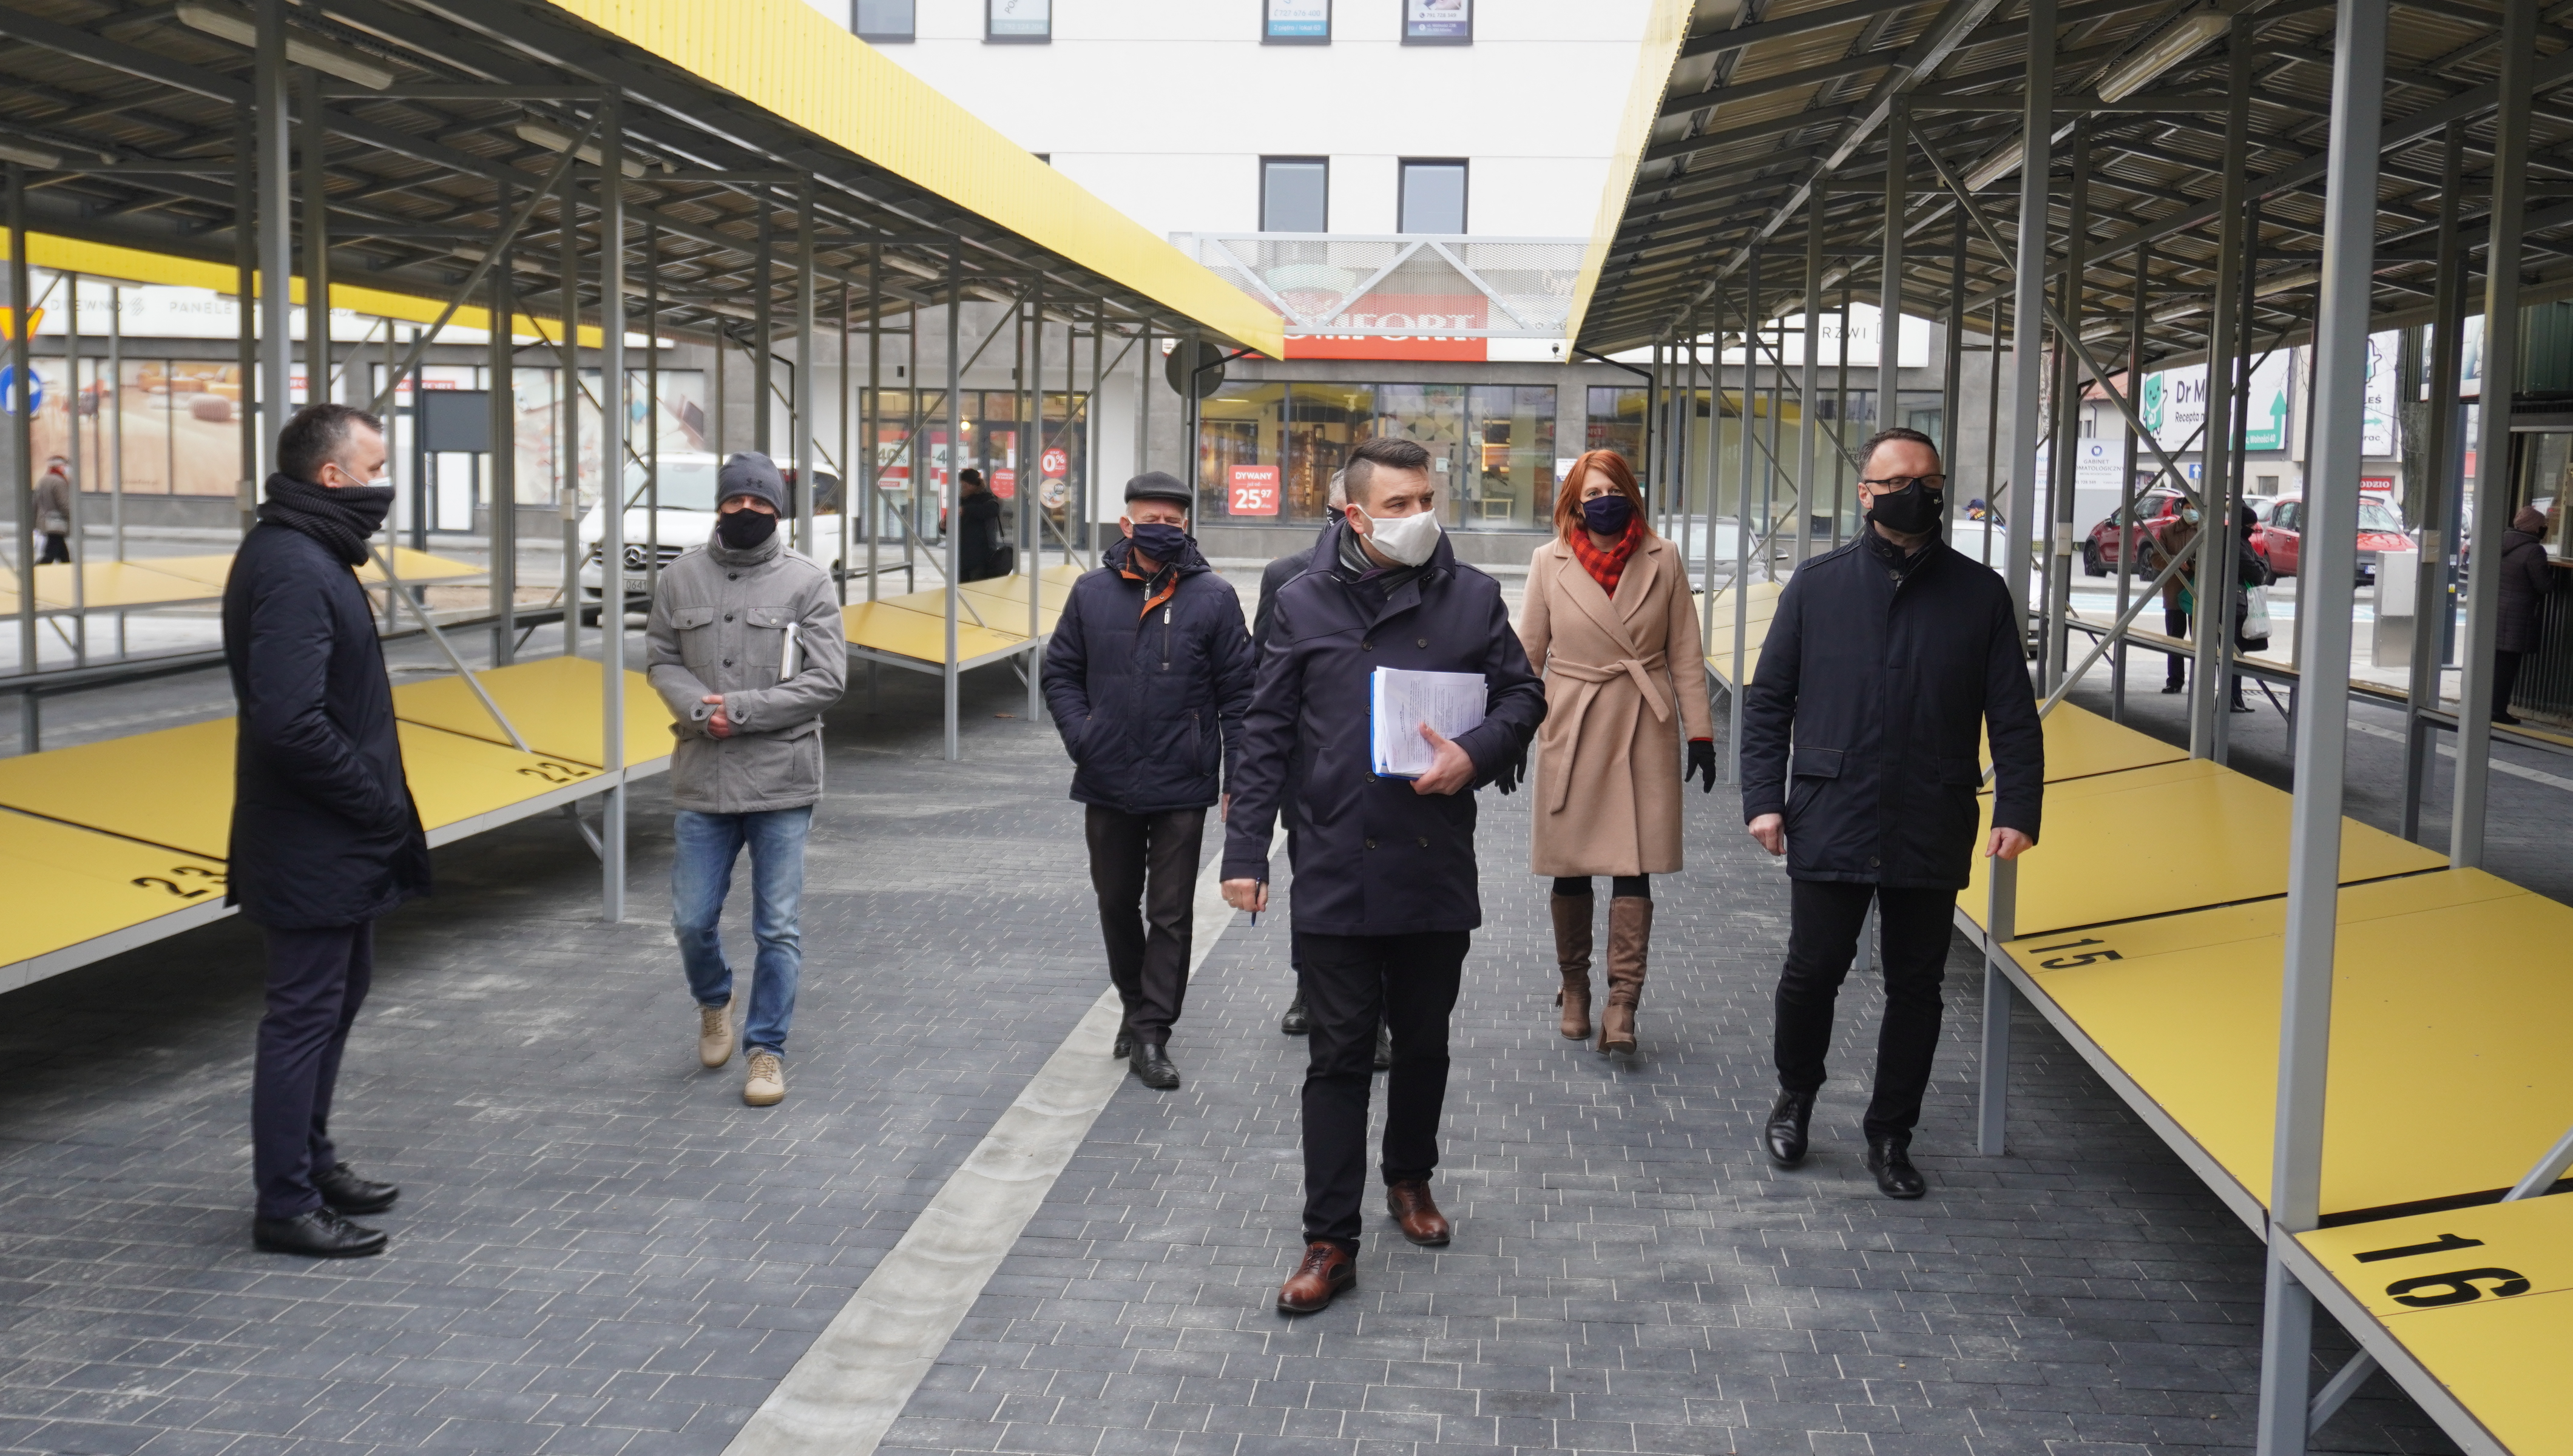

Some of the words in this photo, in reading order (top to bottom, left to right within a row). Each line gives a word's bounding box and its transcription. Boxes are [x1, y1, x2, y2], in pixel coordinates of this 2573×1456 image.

[50, 299, 123, 312] DEWNO
[169, 302, 232, 314] PANELE
[1822, 326, 1866, 340] RZWI
[2176, 380, 2192, 404] Dr
[2175, 411, 2199, 425] Recepta
[1235, 471, 1273, 480] DYWANY
[1235, 488, 1261, 509] 25
[1260, 489, 1273, 498] 97
[516, 762, 591, 783] 22
[129, 866, 229, 898] 23
[2029, 938, 2124, 970] 15
[2353, 1233, 2532, 1307] 16
